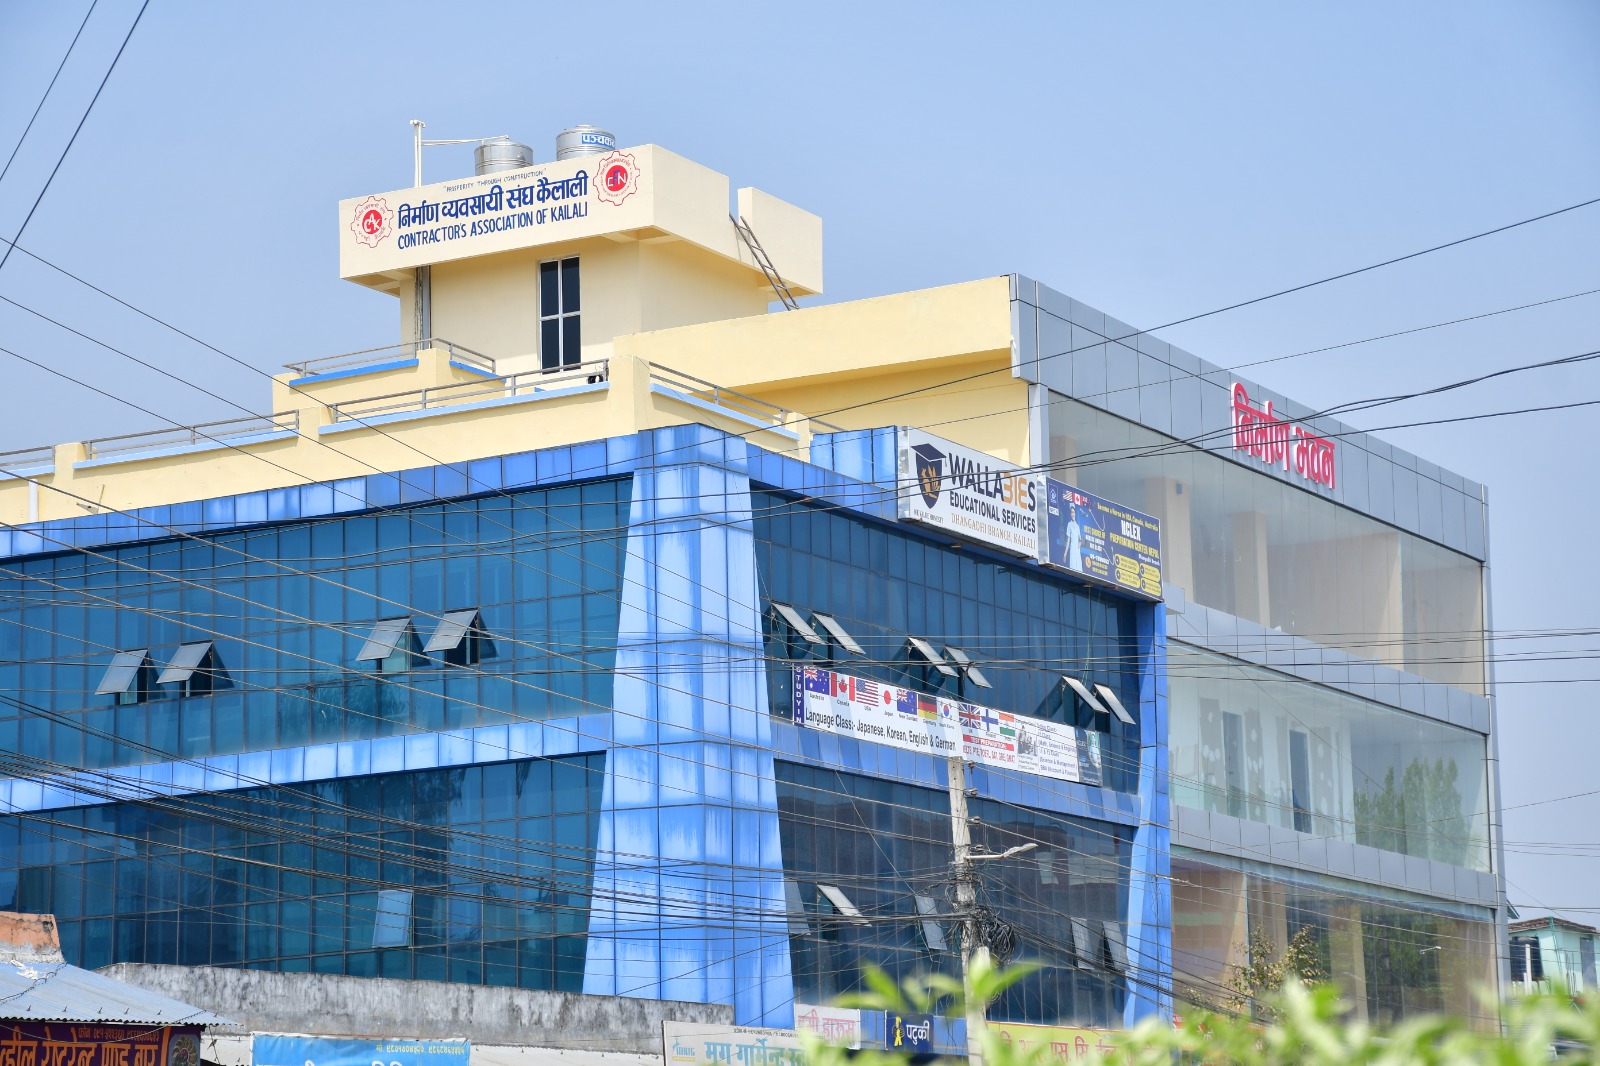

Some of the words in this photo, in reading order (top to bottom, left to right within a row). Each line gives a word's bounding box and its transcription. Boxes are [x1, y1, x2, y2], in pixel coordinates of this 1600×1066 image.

[398, 200, 440, 229] निर्माण
[442, 185, 504, 219] व्यवसायी
[506, 184, 535, 209] संघ
[537, 170, 589, 203] कैलाली
[477, 178, 501, 186] THROUGH
[397, 223, 467, 250] CONTRACTOR'S
[470, 211, 533, 237] ASSOCIATION
[536, 208, 548, 225] OF
[550, 201, 588, 222] KAILALI
[1231, 382, 1290, 471] निर्माण
[1292, 426, 1335, 490] भवन
[948, 452, 1036, 512] WALLABIES
[950, 490, 1000, 522] EDUCATIONAL
[1001, 508, 1036, 534] SERVICES
[951, 513, 987, 533] DHANGADHI
[1013, 533, 1036, 549] KAILALI
[1121, 519, 1141, 541] NCLEX
[1110, 532, 1134, 550] PREPARATION
[805, 707, 835, 728] Language
[856, 719, 885, 739] Japanese,
[886, 726, 908, 743] Korean,
[908, 730, 928, 747] English
[929, 735, 934, 747] &
